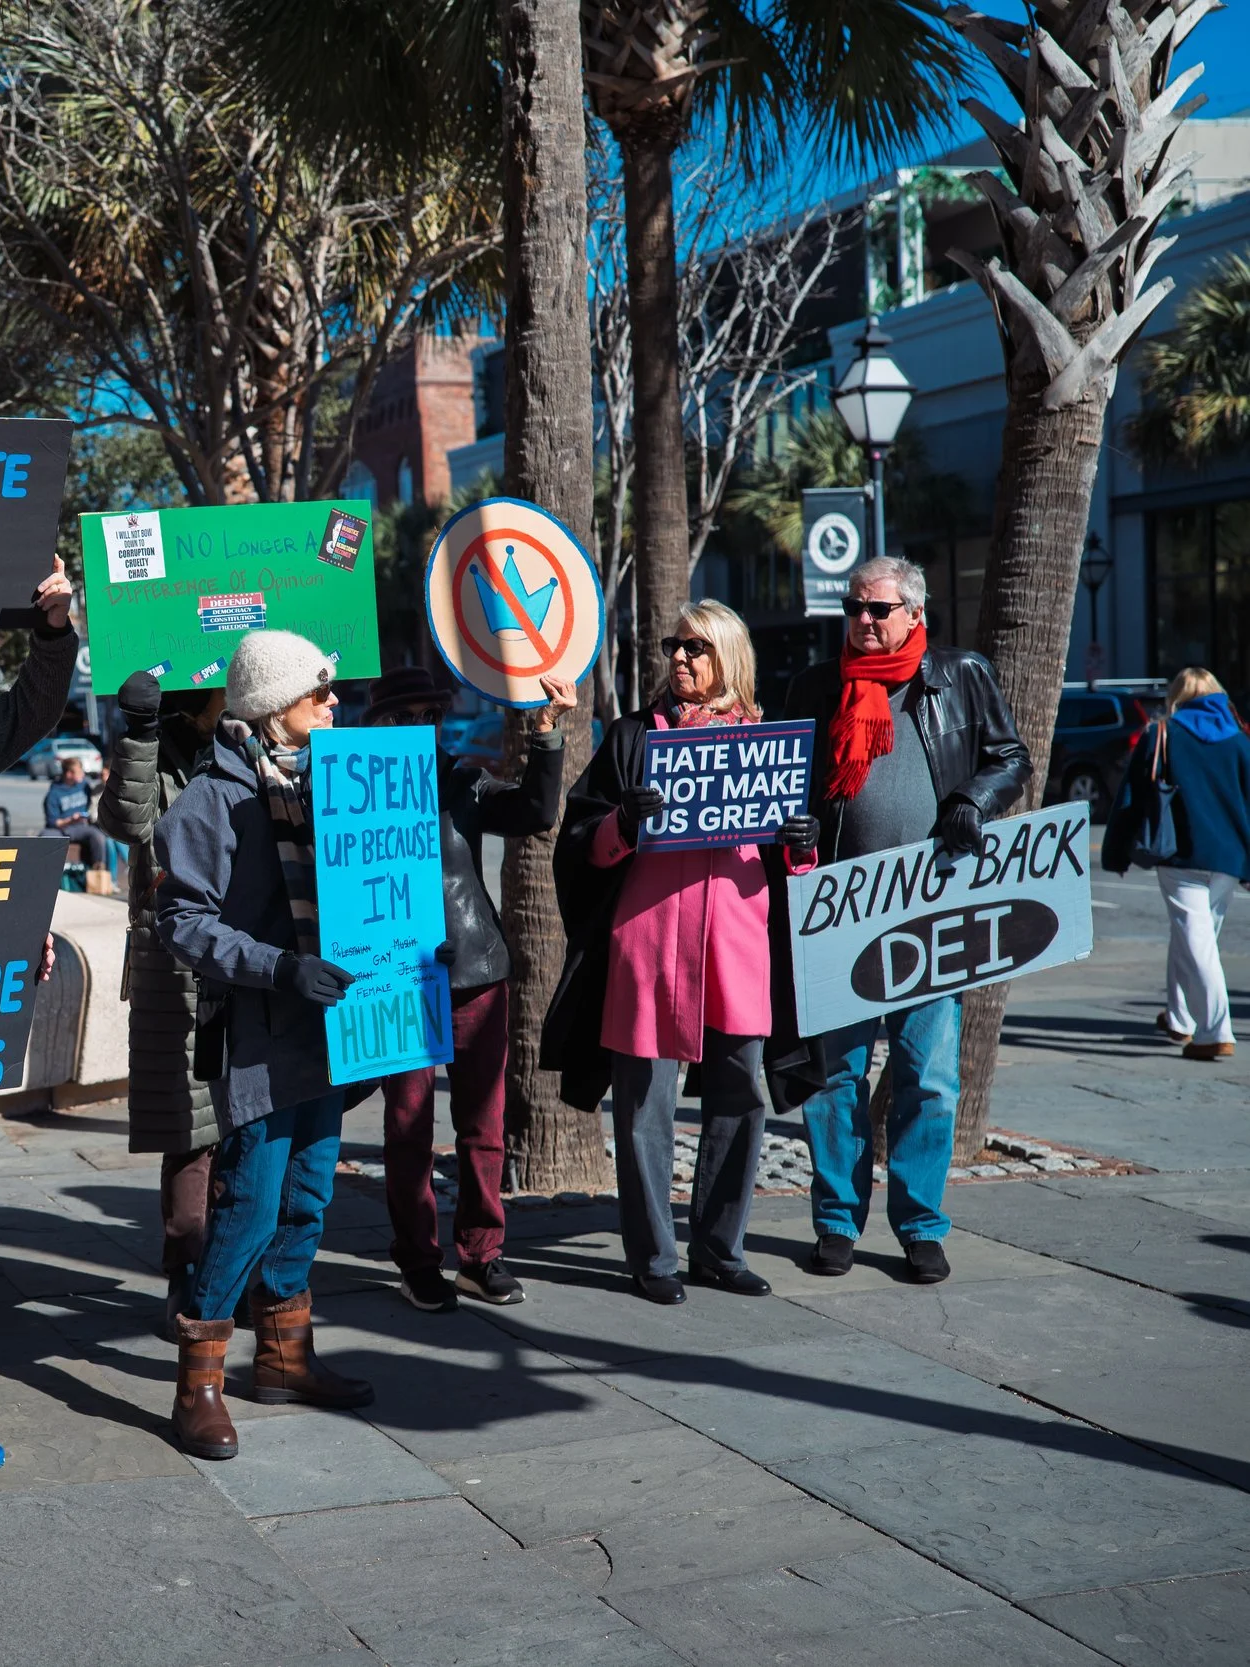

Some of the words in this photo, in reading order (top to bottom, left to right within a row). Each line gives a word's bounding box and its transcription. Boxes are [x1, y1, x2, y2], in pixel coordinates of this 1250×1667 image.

[118, 547, 155, 559] CORRUPTION
[176, 531, 213, 560] NO
[305, 530, 317, 554] A
[125, 557, 149, 569] CRUELTY
[128, 568, 149, 579] CHAOS
[104, 577, 218, 605] DIFFERENCE
[816, 579, 850, 593] SEW
[210, 597, 253, 607] DEFEND!
[212, 607, 252, 615] DEMOCRACY
[210, 615, 256, 624] CONSTITUTION
[218, 623, 249, 631] FREEDOM
[147, 664, 165, 677] TAND
[201, 661, 221, 679] SPEAK
[651, 743, 730, 774] HATE
[738, 738, 807, 768] WILL
[320, 753, 338, 817] I
[346, 752, 438, 817] SPEAK
[722, 768, 806, 800] MAKE
[645, 808, 689, 835] US
[324, 832, 357, 868] UP
[361, 820, 439, 865] BECAUSE
[799, 850, 956, 936] BRING
[968, 817, 1087, 890] BACK
[362, 871, 412, 925] I'M
[372, 950, 391, 966] GAY
[880, 904, 1014, 1000] DEI
[356, 983, 393, 1000] FEMALE
[338, 984, 444, 1066] HUMAN
